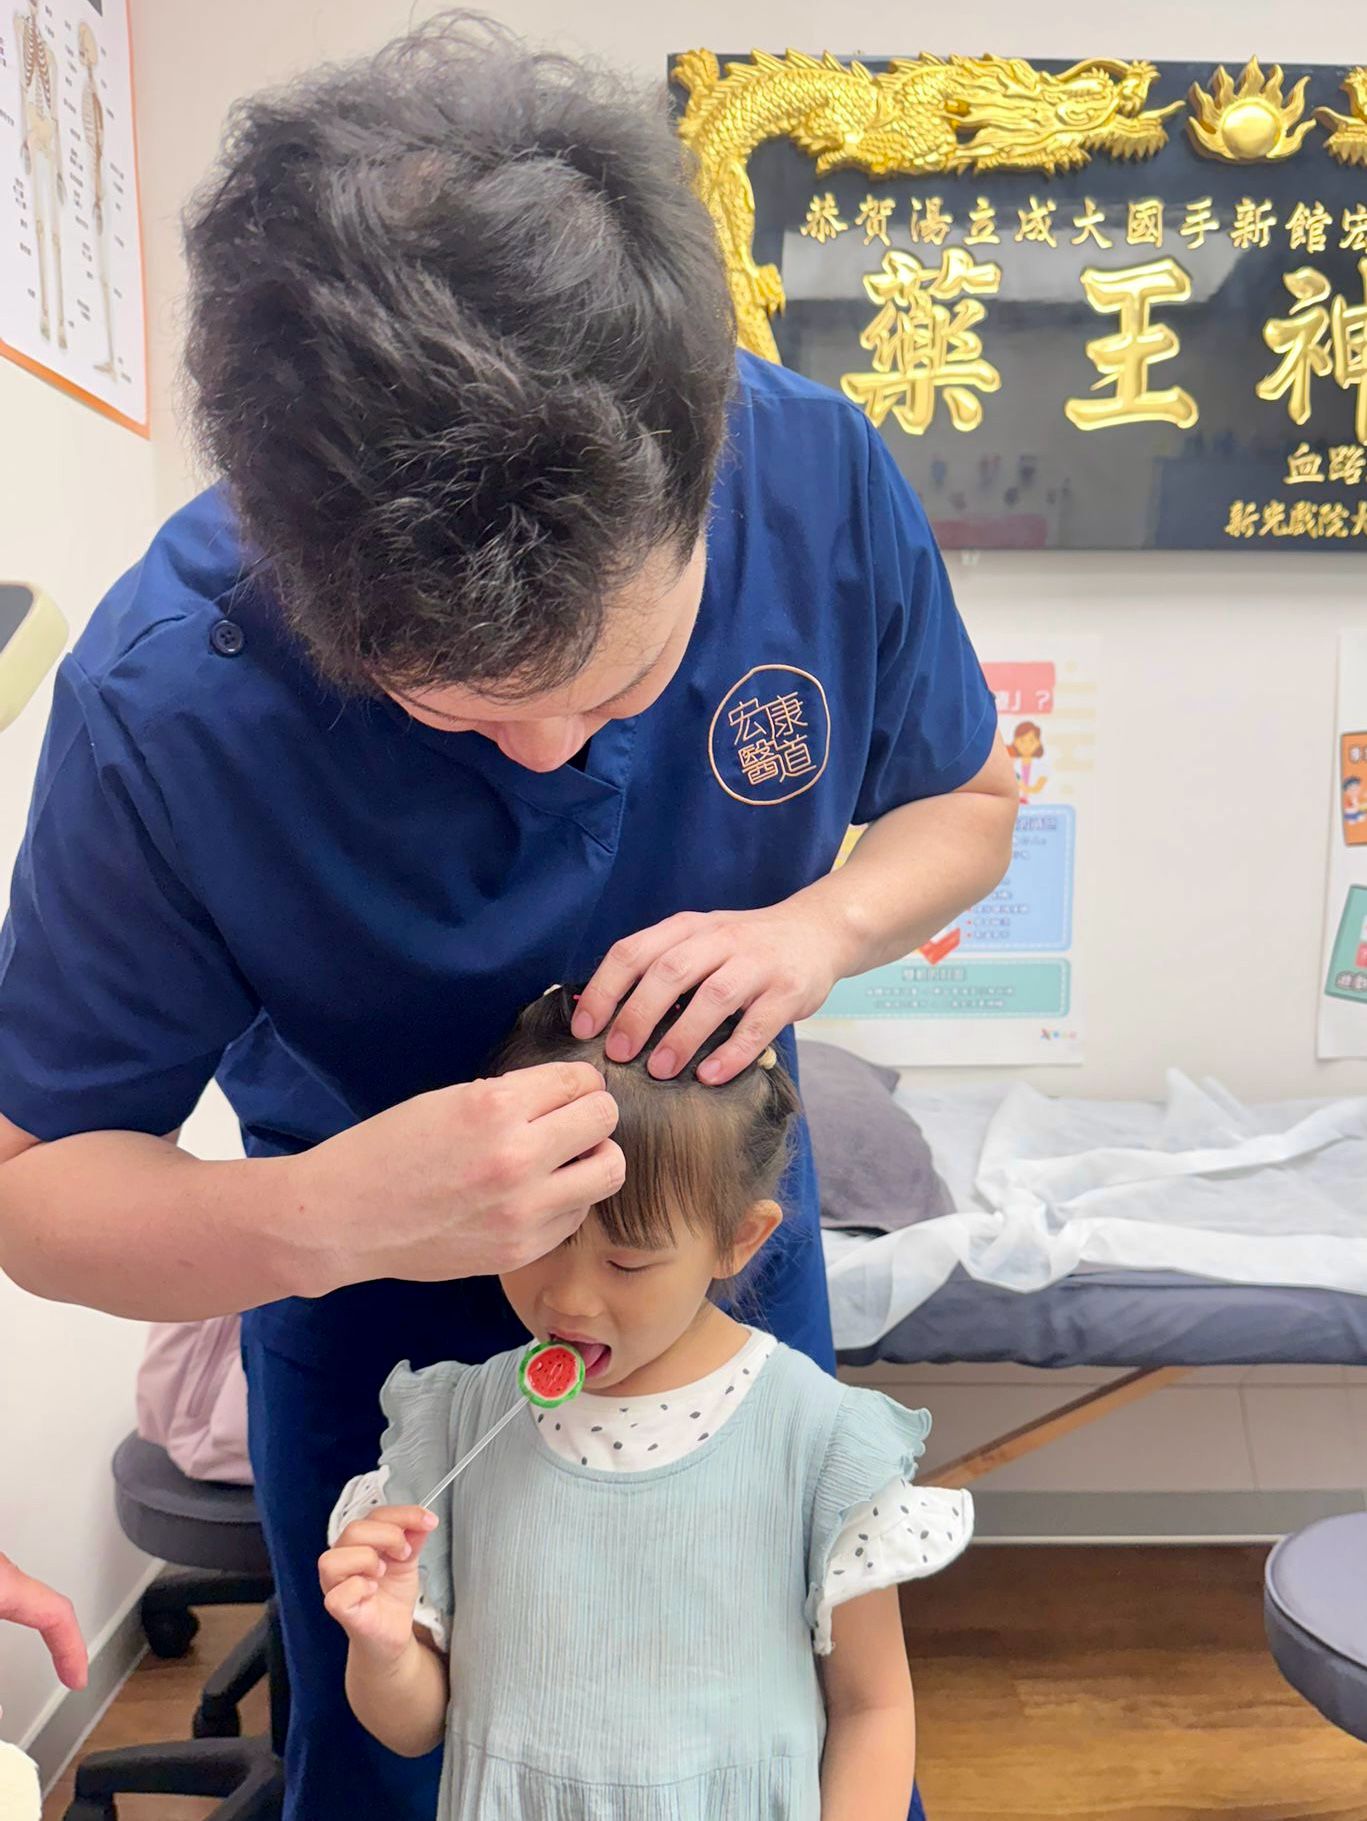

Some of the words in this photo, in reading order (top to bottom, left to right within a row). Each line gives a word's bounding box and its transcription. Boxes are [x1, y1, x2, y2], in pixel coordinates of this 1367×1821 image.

[841, 247, 1367, 445] 藥王神
[728, 691, 809, 746] 宏康
[738, 733, 817, 786] 醫道
